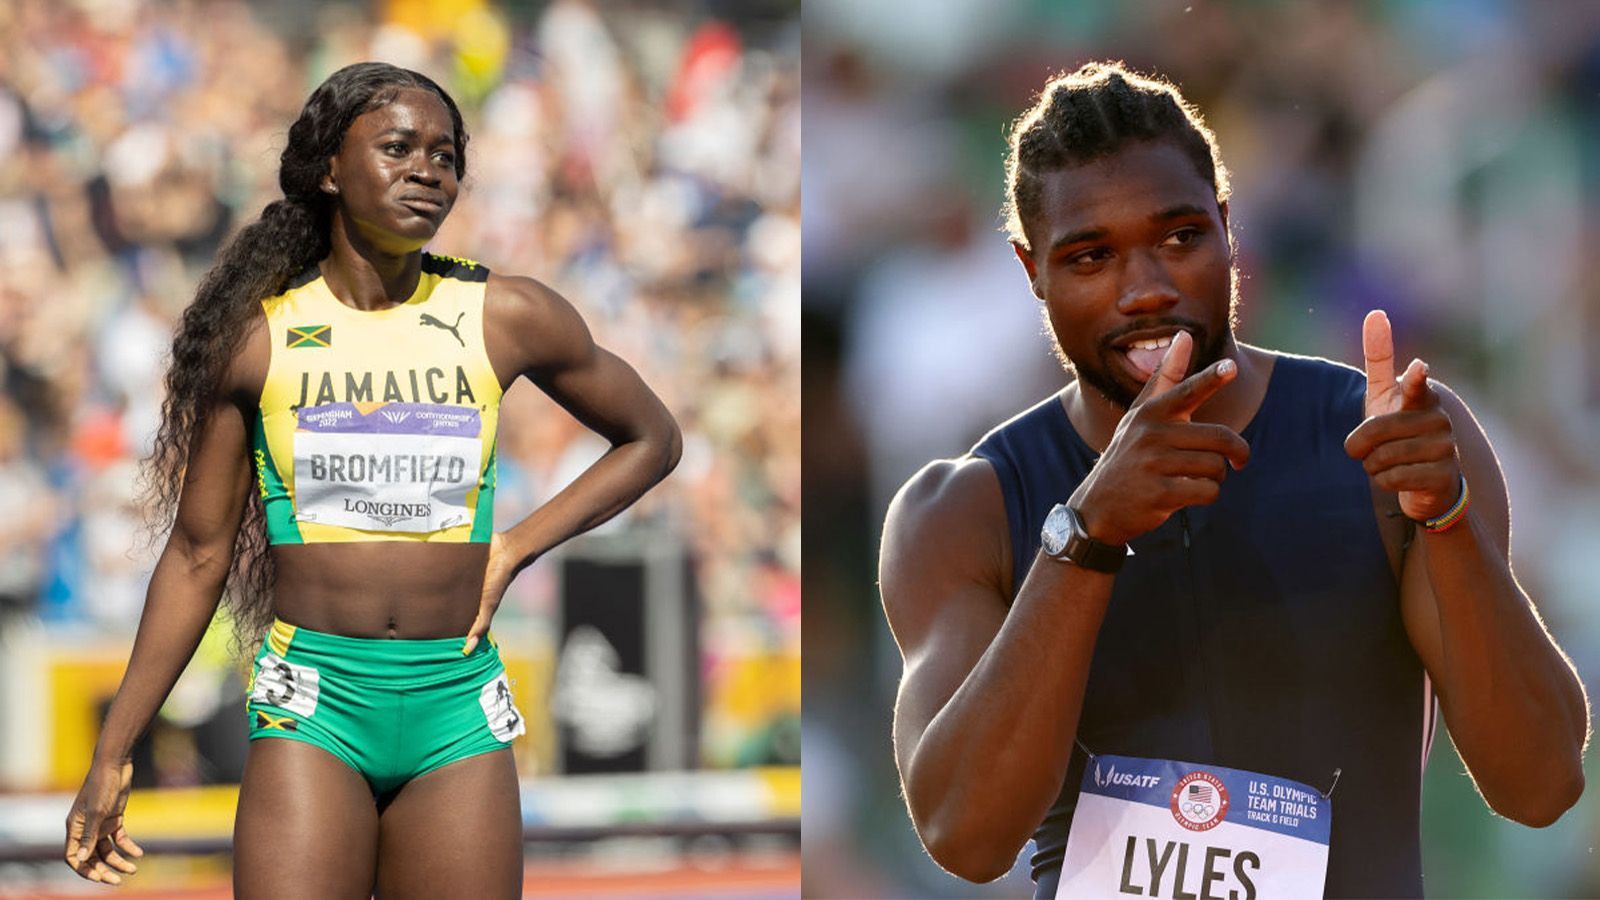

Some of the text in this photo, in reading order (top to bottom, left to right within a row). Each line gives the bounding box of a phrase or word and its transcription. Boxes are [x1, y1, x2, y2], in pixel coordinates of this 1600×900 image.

[293, 366, 476, 409] JAMAICA
[311, 454, 466, 484] BROMFIELD
[344, 498, 432, 518] LONGINES
[266, 662, 296, 707] 3
[1113, 772, 1160, 788] USATF
[1249, 780, 1317, 805] U.S. OLYMPIC
[1247, 795, 1317, 819] TEAM TRIALS
[1247, 810, 1271, 823] TRACK
[1280, 815, 1299, 827] FIELD
[1119, 835, 1261, 900] LYLES
